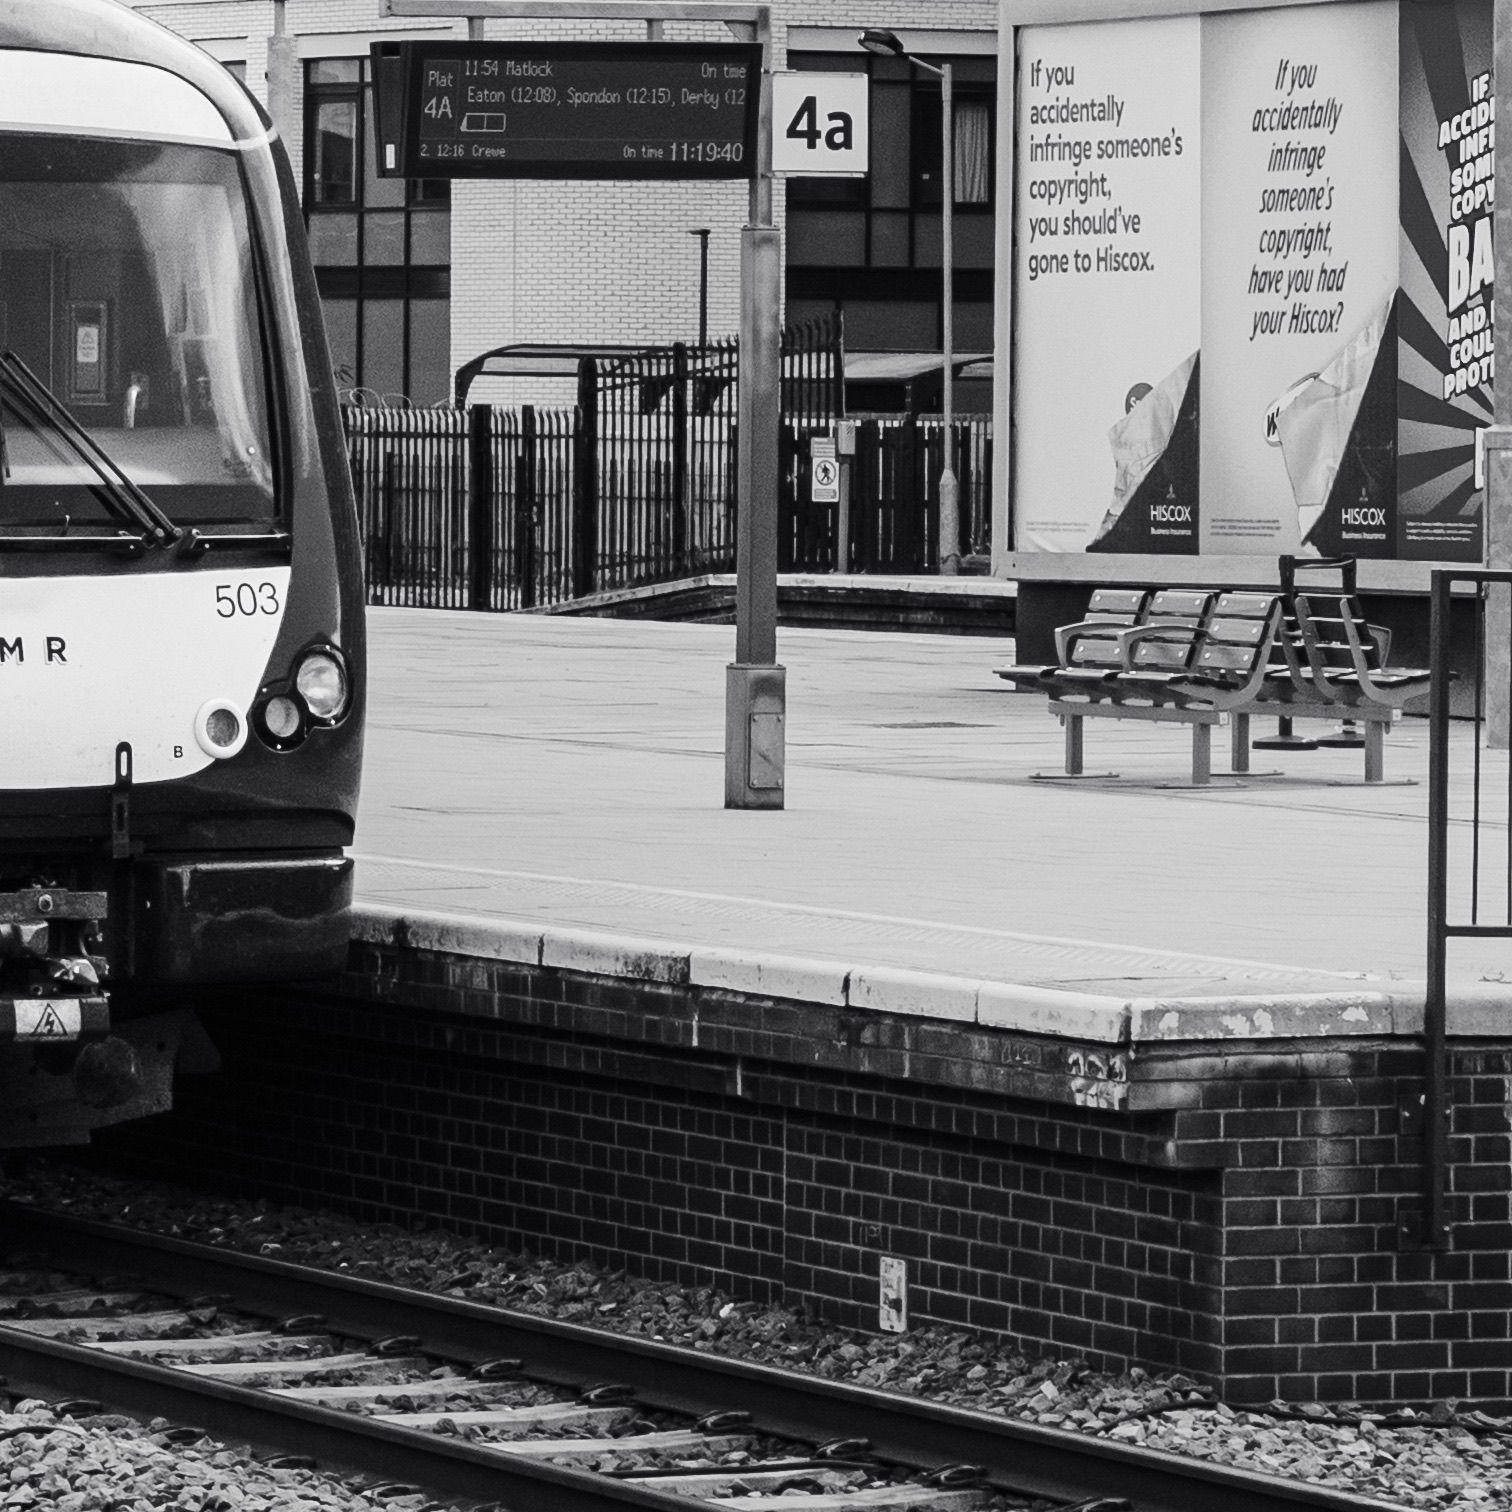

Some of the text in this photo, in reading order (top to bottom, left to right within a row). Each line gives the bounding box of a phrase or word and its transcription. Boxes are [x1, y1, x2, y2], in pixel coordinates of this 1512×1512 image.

[428, 70, 454, 88] Plat
[505, 60, 553, 77] Matlock
[701, 62, 747, 78] On time
[1031, 59, 1075, 93] If you
[1275, 59, 1318, 97] If you
[467, 85, 506, 103] Eaton
[567, 87, 621, 108] Spondon
[681, 88, 720, 110] Derby
[1472, 72, 1489, 103] IF
[424, 95, 453, 119] 4A
[786, 96, 853, 151] 4a
[1030, 94, 1125, 127] accidentally
[1252, 97, 1343, 135] accidentally
[472, 144, 506, 158] Crewe
[623, 145, 664, 158] On time
[669, 142, 744, 161] 11:19:40
[1030, 133, 1092, 167] infringe
[1267, 141, 1326, 177] infringe
[1029, 170, 1112, 205] copyright,
[1451, 150, 1495, 195] SOM
[1029, 215, 1058, 243] you
[1259, 221, 1332, 260] copyright,
[1029, 244, 1154, 281] gone to Hiscox.
[1248, 261, 1348, 300] have you had
[1249, 301, 1344, 342] your Hiscox?
[1448, 305, 1487, 344] AND
[1150, 504, 1192, 522] HISCOX
[1341, 507, 1386, 525] HISCOX
[215, 582, 280, 618] 503
[174, 745, 184, 758] B
